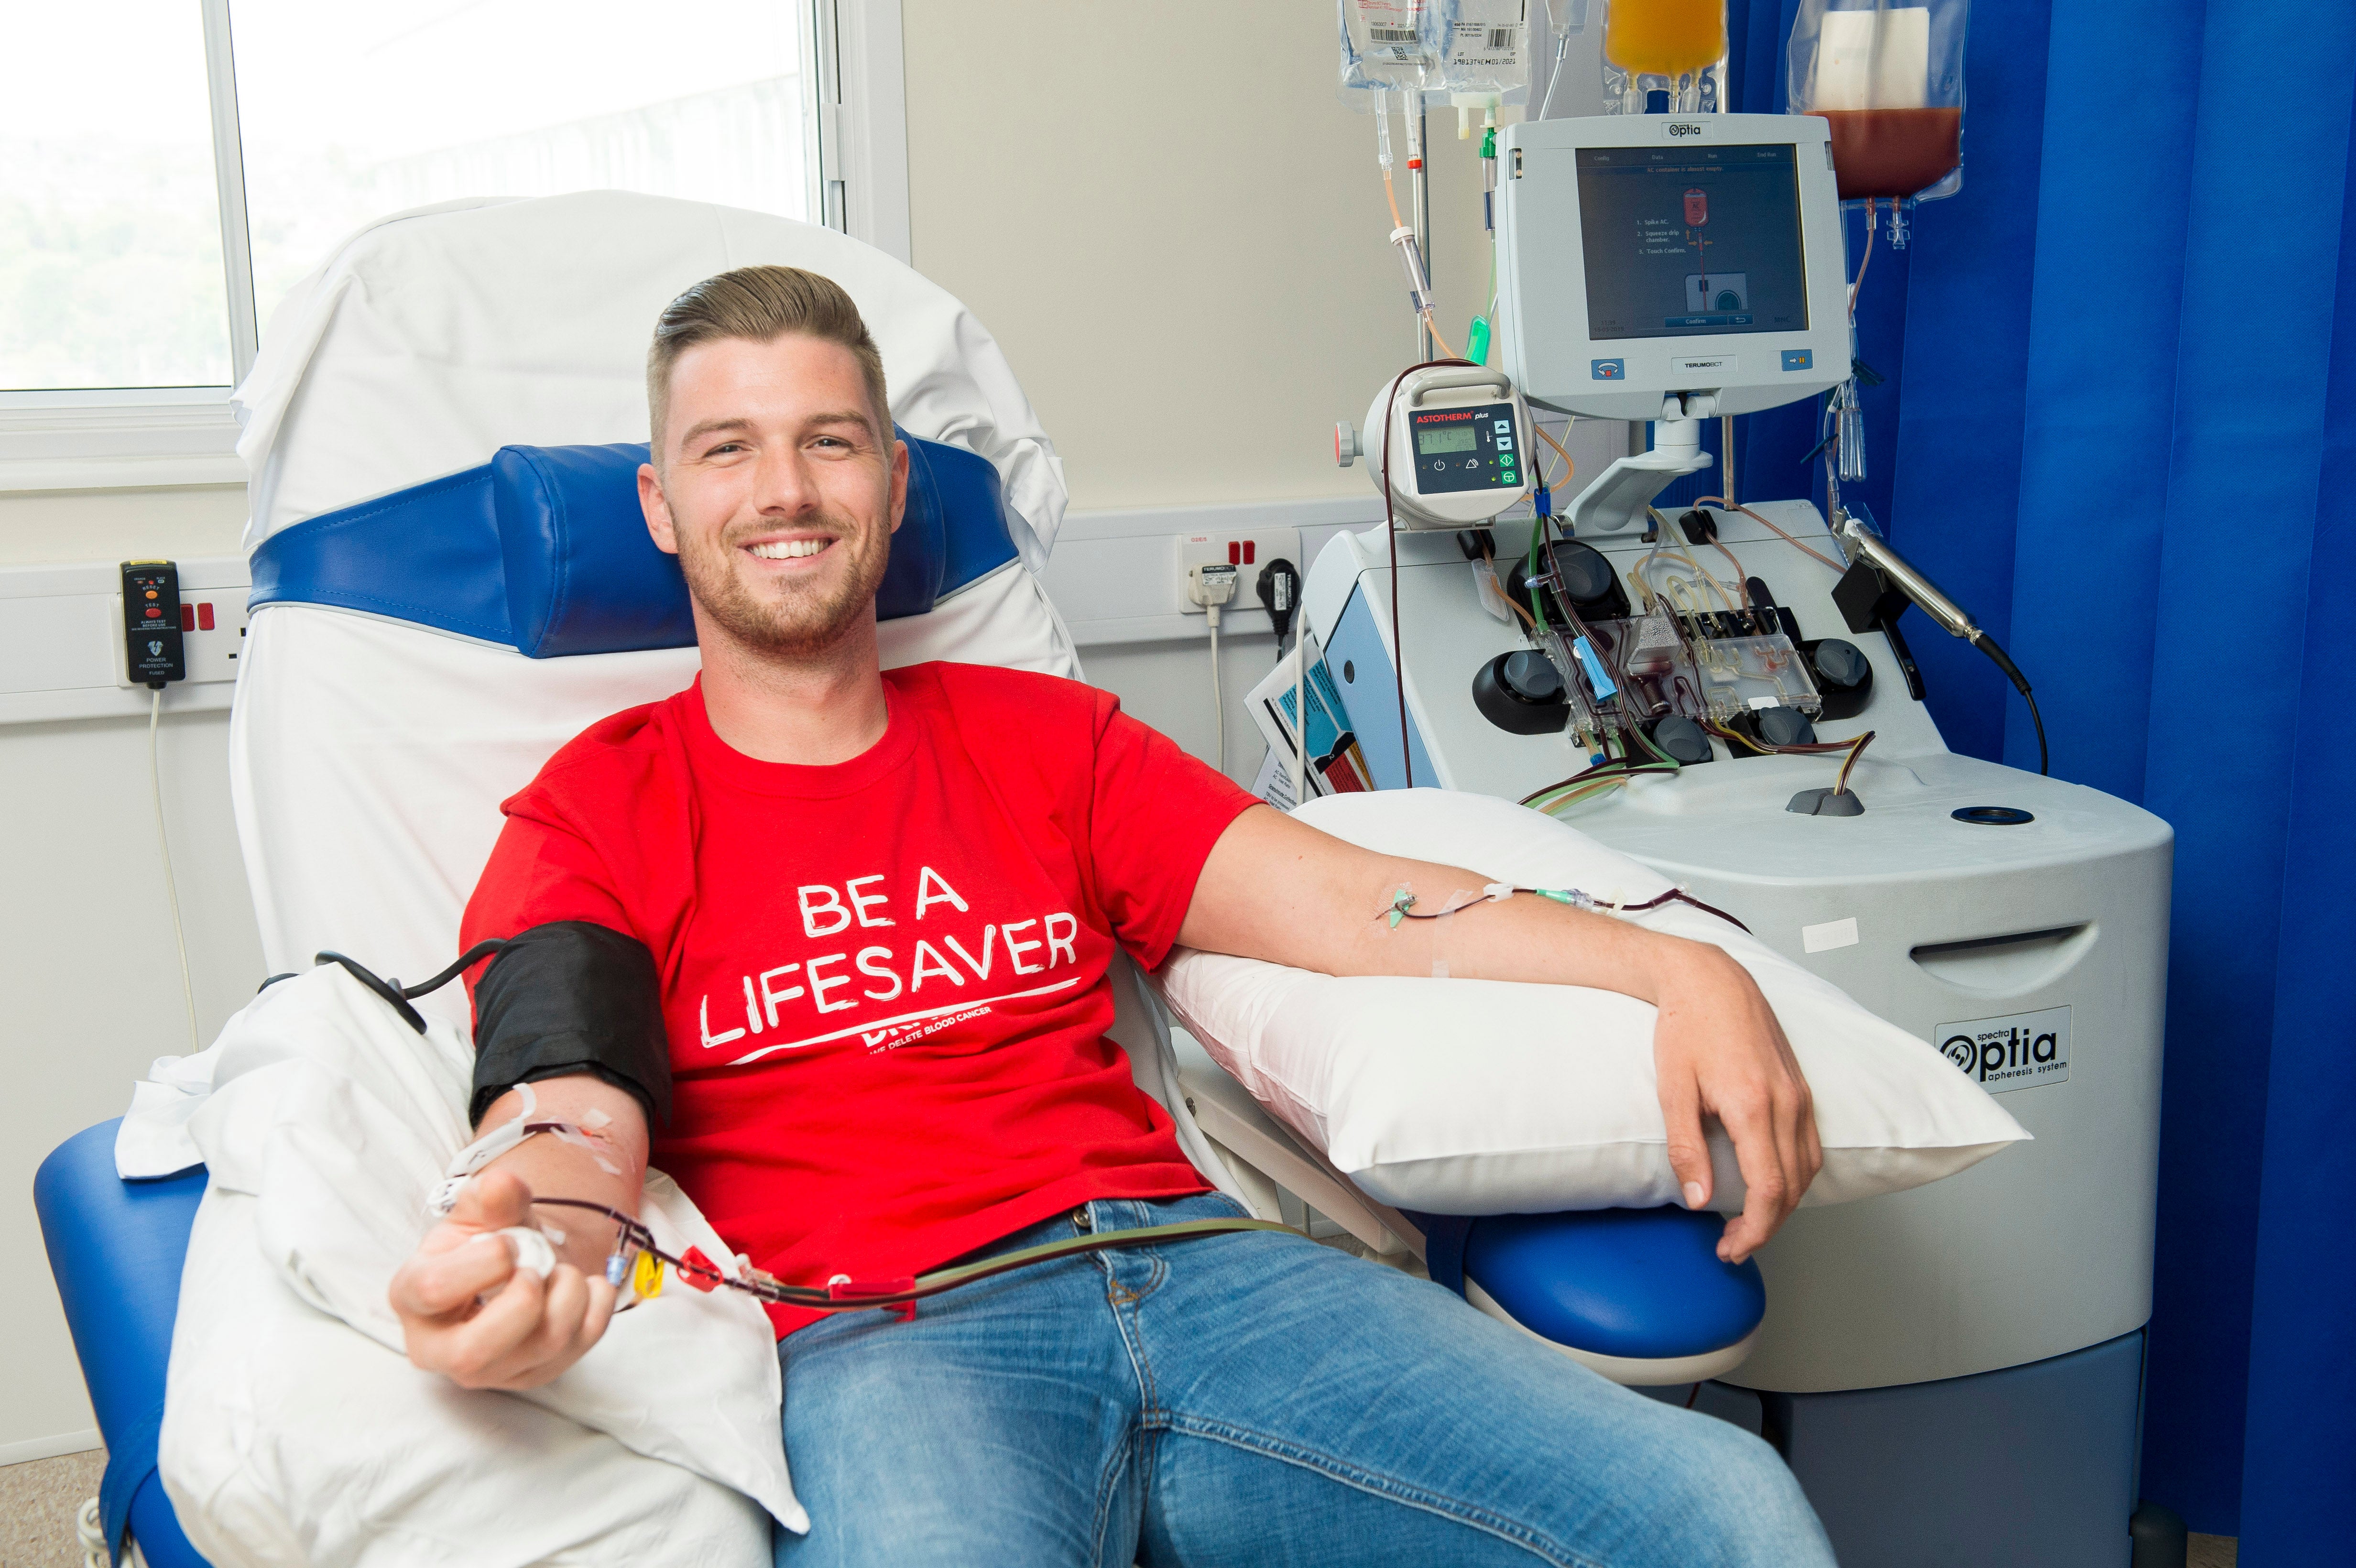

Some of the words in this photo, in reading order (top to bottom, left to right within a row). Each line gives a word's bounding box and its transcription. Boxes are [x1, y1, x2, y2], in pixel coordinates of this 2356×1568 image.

[1669, 124, 1701, 138] Optia
[1267, 783, 1285, 797] Granulocyte
[1283, 794, 1298, 806] Collection
[798, 874, 896, 938] BE
[916, 866, 969, 920] A
[700, 912, 1077, 1048] LIFESAVER
[888, 1029, 924, 1050] DELETE
[924, 1017, 956, 1035] BLOOD
[956, 1006, 992, 1022] CANCER
[1977, 1029, 2010, 1042] spectra
[1940, 1027, 2057, 1082] Optia
[1988, 1067, 2033, 1082] apheresis
[2038, 1061, 2067, 1073] system
